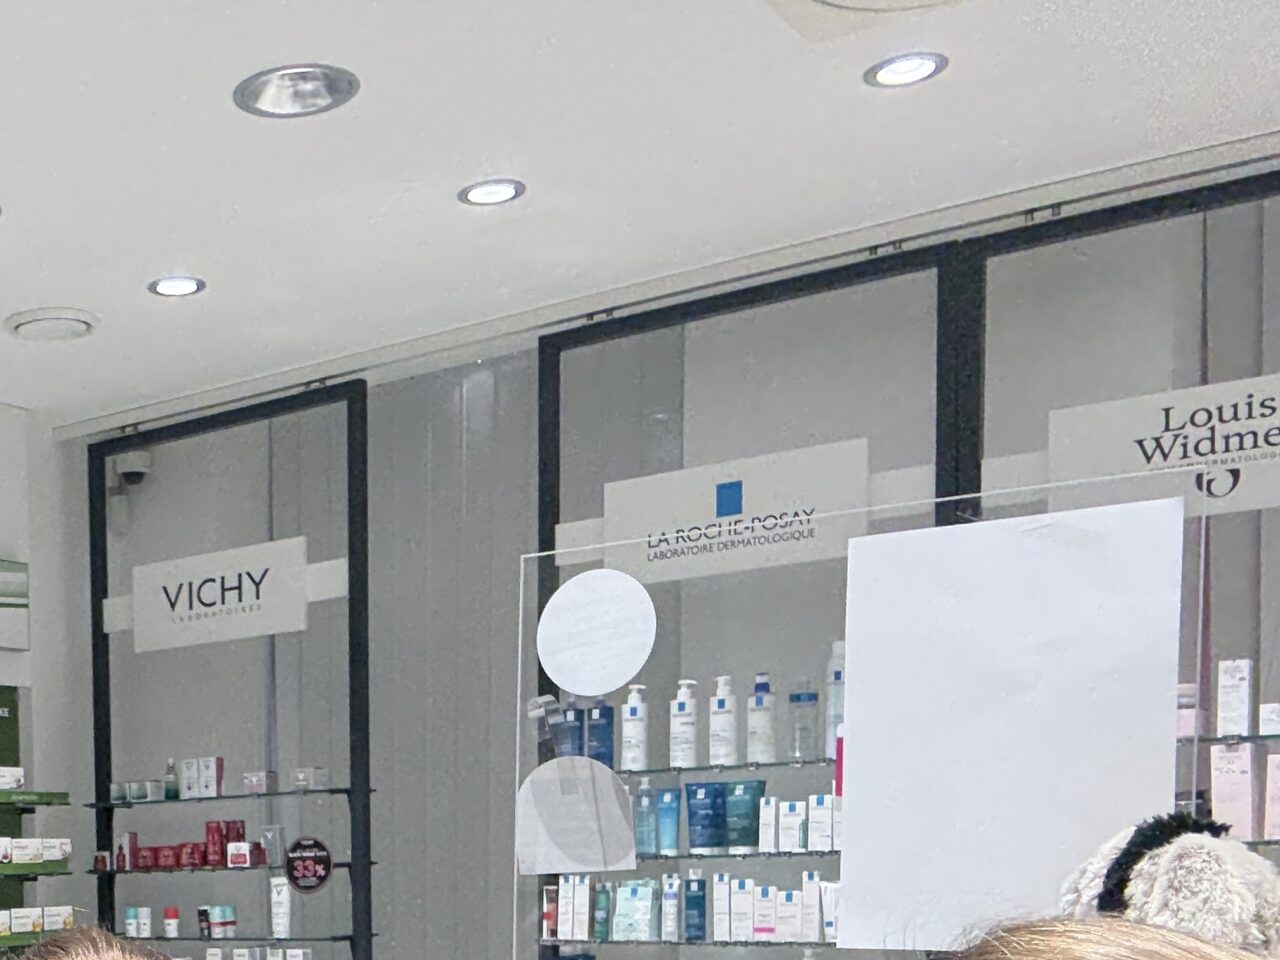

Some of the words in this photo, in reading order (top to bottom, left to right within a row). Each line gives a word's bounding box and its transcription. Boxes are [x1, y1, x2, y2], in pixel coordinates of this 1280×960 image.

[1161, 394, 1278, 433] Louis
[1134, 426, 1280, 465] Widme
[647, 542, 715, 562] LABORATOIRE
[716, 528, 816, 551] DERMATOLOGIQUE
[162, 568, 270, 611] VICHY
